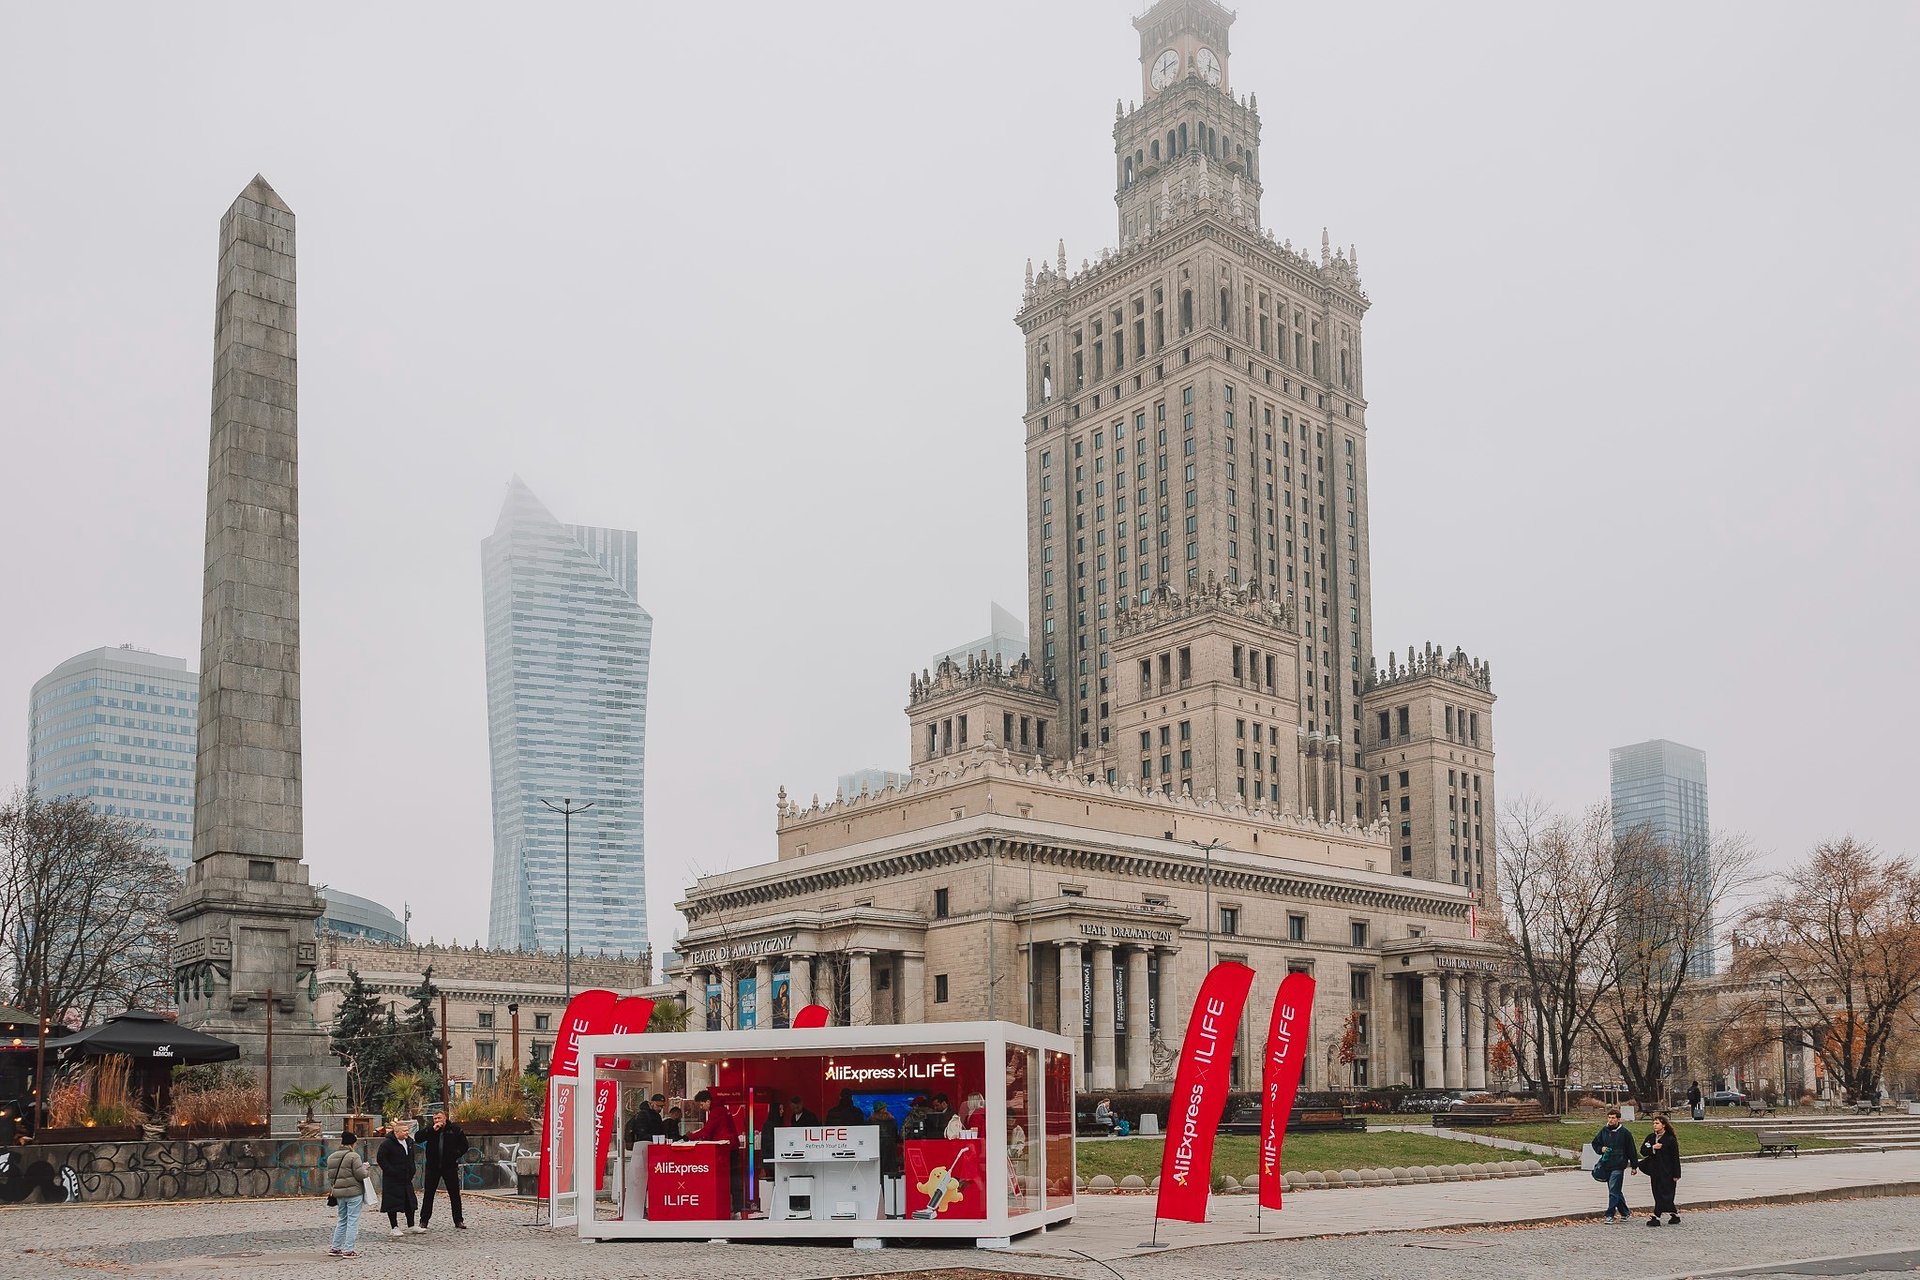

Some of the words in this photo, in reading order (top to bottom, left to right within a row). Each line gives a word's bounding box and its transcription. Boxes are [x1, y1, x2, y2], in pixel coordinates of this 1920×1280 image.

[1079, 924, 1107, 936] TEATR
[1112, 926, 1173, 942] DRAMATYCZNY
[690, 947, 717, 964] TEATR
[1437, 957, 1457, 969] TEATR
[1272, 1003, 1295, 1064] ILIFE
[825, 1065, 896, 1083] AliExpress
[909, 1063, 956, 1079] ILIFE
[1172, 1083, 1204, 1187] AliExpress
[1194, 997, 1225, 1064] ILIFE
[804, 1128, 848, 1141] ILIFE
[654, 1161, 710, 1177] AliExpress
[664, 1194, 700, 1206] ILIFE
